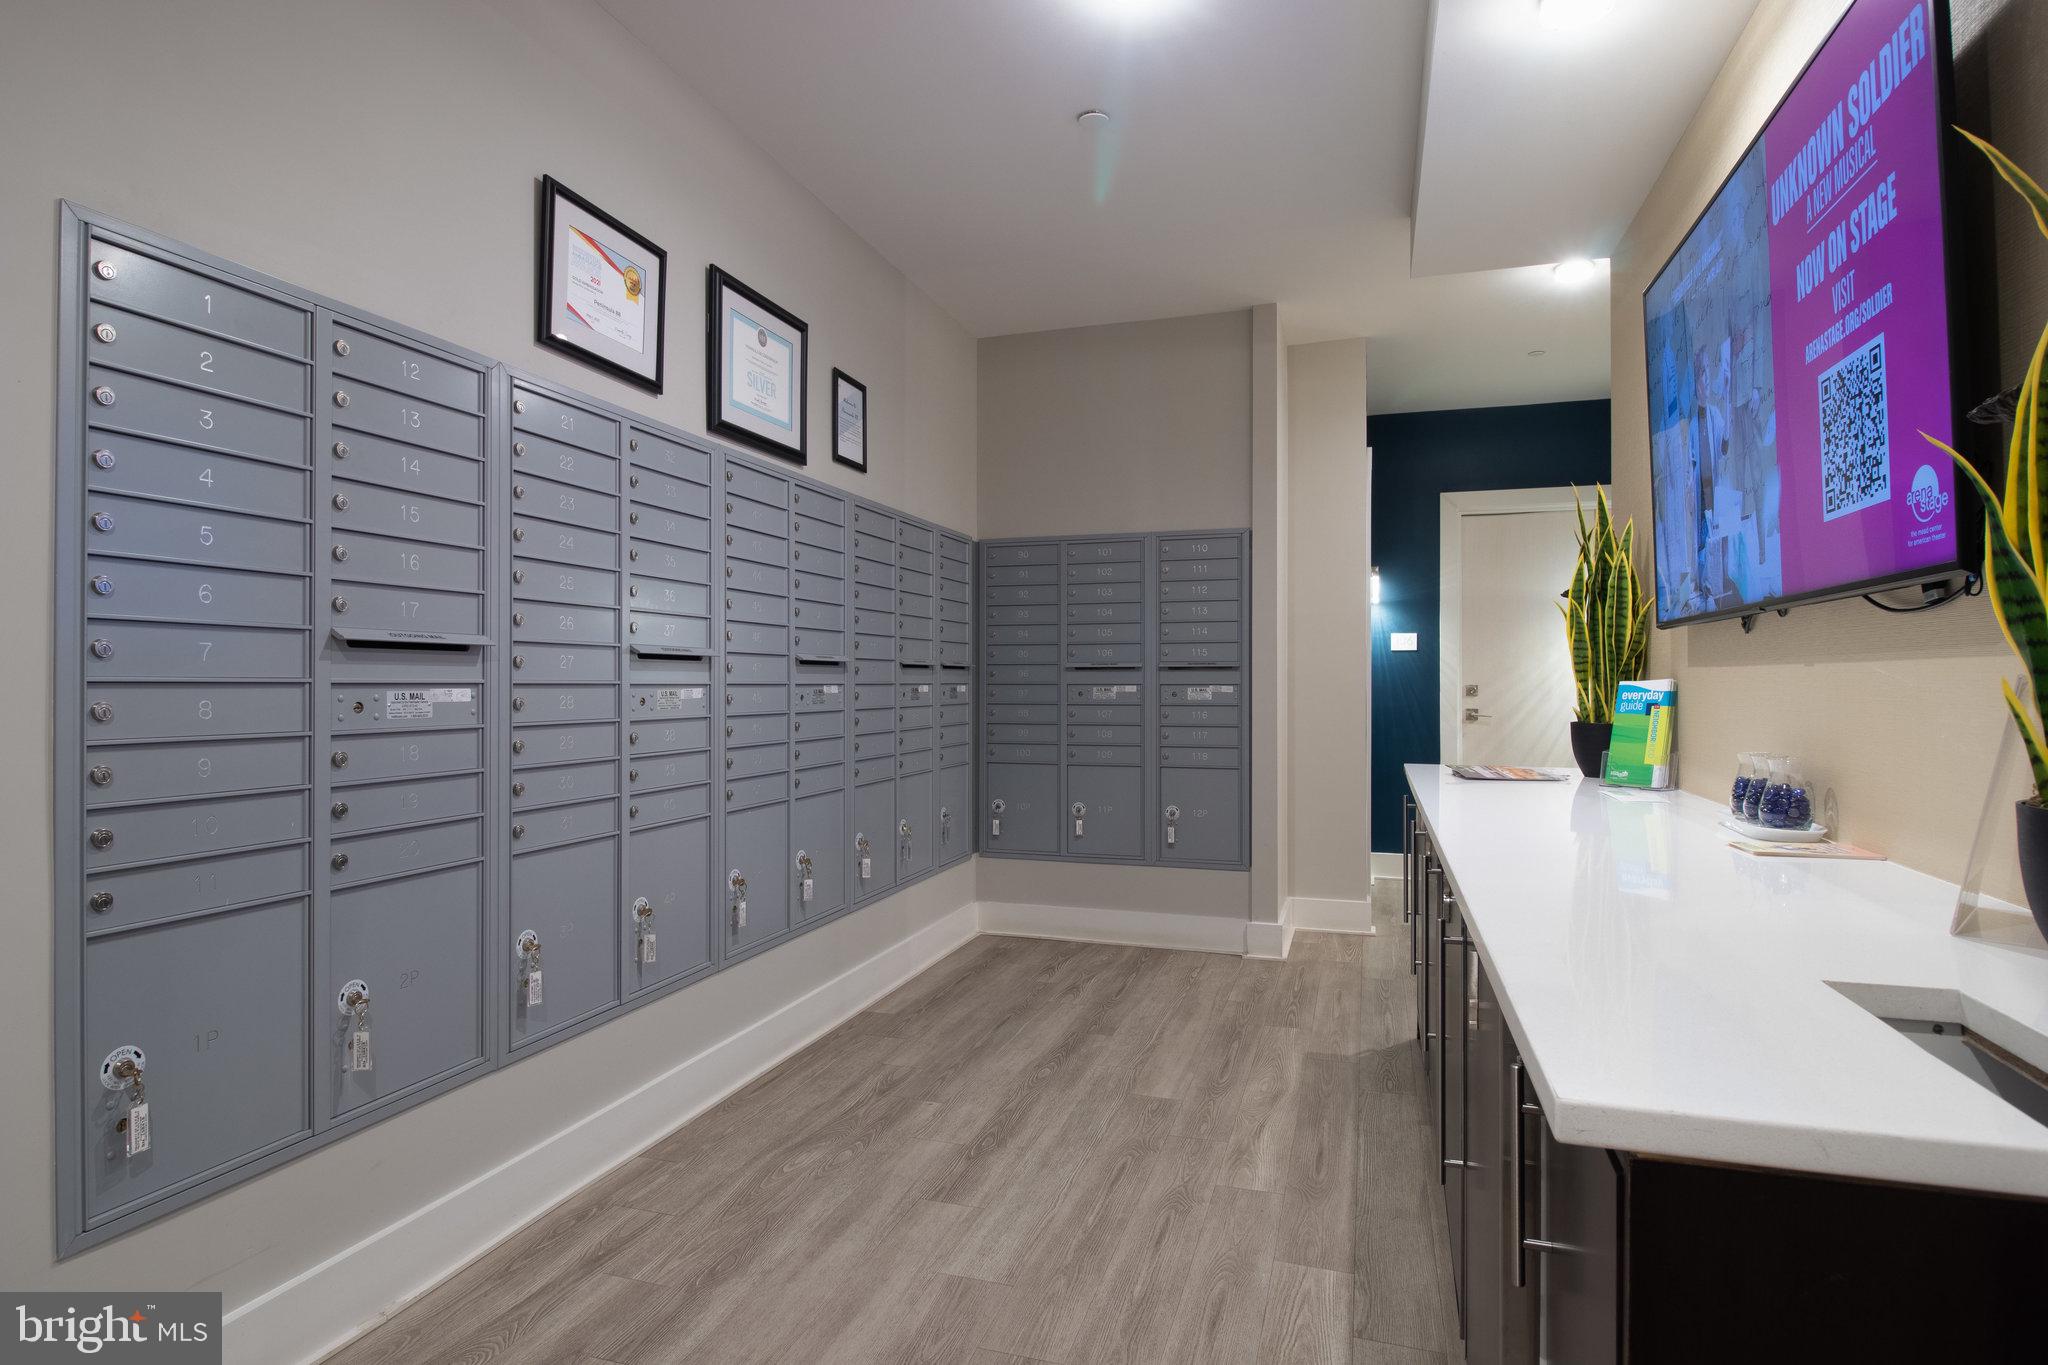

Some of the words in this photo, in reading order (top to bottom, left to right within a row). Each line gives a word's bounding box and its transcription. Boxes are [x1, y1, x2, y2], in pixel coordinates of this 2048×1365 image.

[1771, 101, 1844, 226] UNKNOWN
[1847, 3, 1926, 138] SOLDIER
[1806, 200, 1813, 224] A
[1814, 175, 1833, 216] NEW
[1834, 125, 1877, 195] MUSICAL
[1796, 245, 1826, 303] NOW
[1828, 221, 1848, 274] ON
[1850, 171, 1898, 255] STAGE
[1832, 269, 1855, 315] VISIT
[205, 295, 212, 315] 1
[1805, 283, 1893, 365] ARENASTAGE.ORG/SOLDIER
[200, 351, 214, 373] 2
[401, 360, 421, 380] 12
[747, 371, 776, 400] SILVER
[200, 409, 214, 430] 3
[401, 408, 421, 428] 13
[561, 415, 575, 431] 21
[401, 456, 421, 476] 14
[560, 455, 574, 471] 22
[199, 468, 214, 488] 4
[560, 495, 575, 511] 23
[1907, 485, 1933, 506] arena
[1920, 491, 1948, 514] stage
[401, 504, 420, 523] 15
[200, 525, 214, 546] 5
[560, 535, 574, 550] 24
[1192, 544, 1208, 552] 110
[401, 552, 420, 571] 16
[1192, 565, 1208, 573] 111
[1097, 568, 1113, 576] 102
[199, 584, 213, 604] 6
[1192, 586, 1208, 594] 112
[401, 601, 419, 618] 17
[1097, 608, 1113, 617] 104
[1192, 607, 1208, 615] 113
[560, 616, 574, 630] 26
[664, 624, 676, 637] 37
[1192, 627, 1208, 635] 114
[199, 642, 213, 662] 7
[1192, 648, 1208, 656] 115
[560, 655, 574, 669] 27
[394, 692, 408, 701] U.S.
[409, 692, 426, 701] MAIL
[560, 695, 574, 709] 28
[1622, 690, 1664, 701] everyday
[199, 700, 213, 720] 8
[1620, 701, 1643, 712] guide
[401, 744, 420, 761] 18
[197, 758, 212, 778] 9
[400, 970, 419, 989] 2P
[194, 1029, 220, 1053] 1P
[110, 1048, 133, 1062] OPEN
